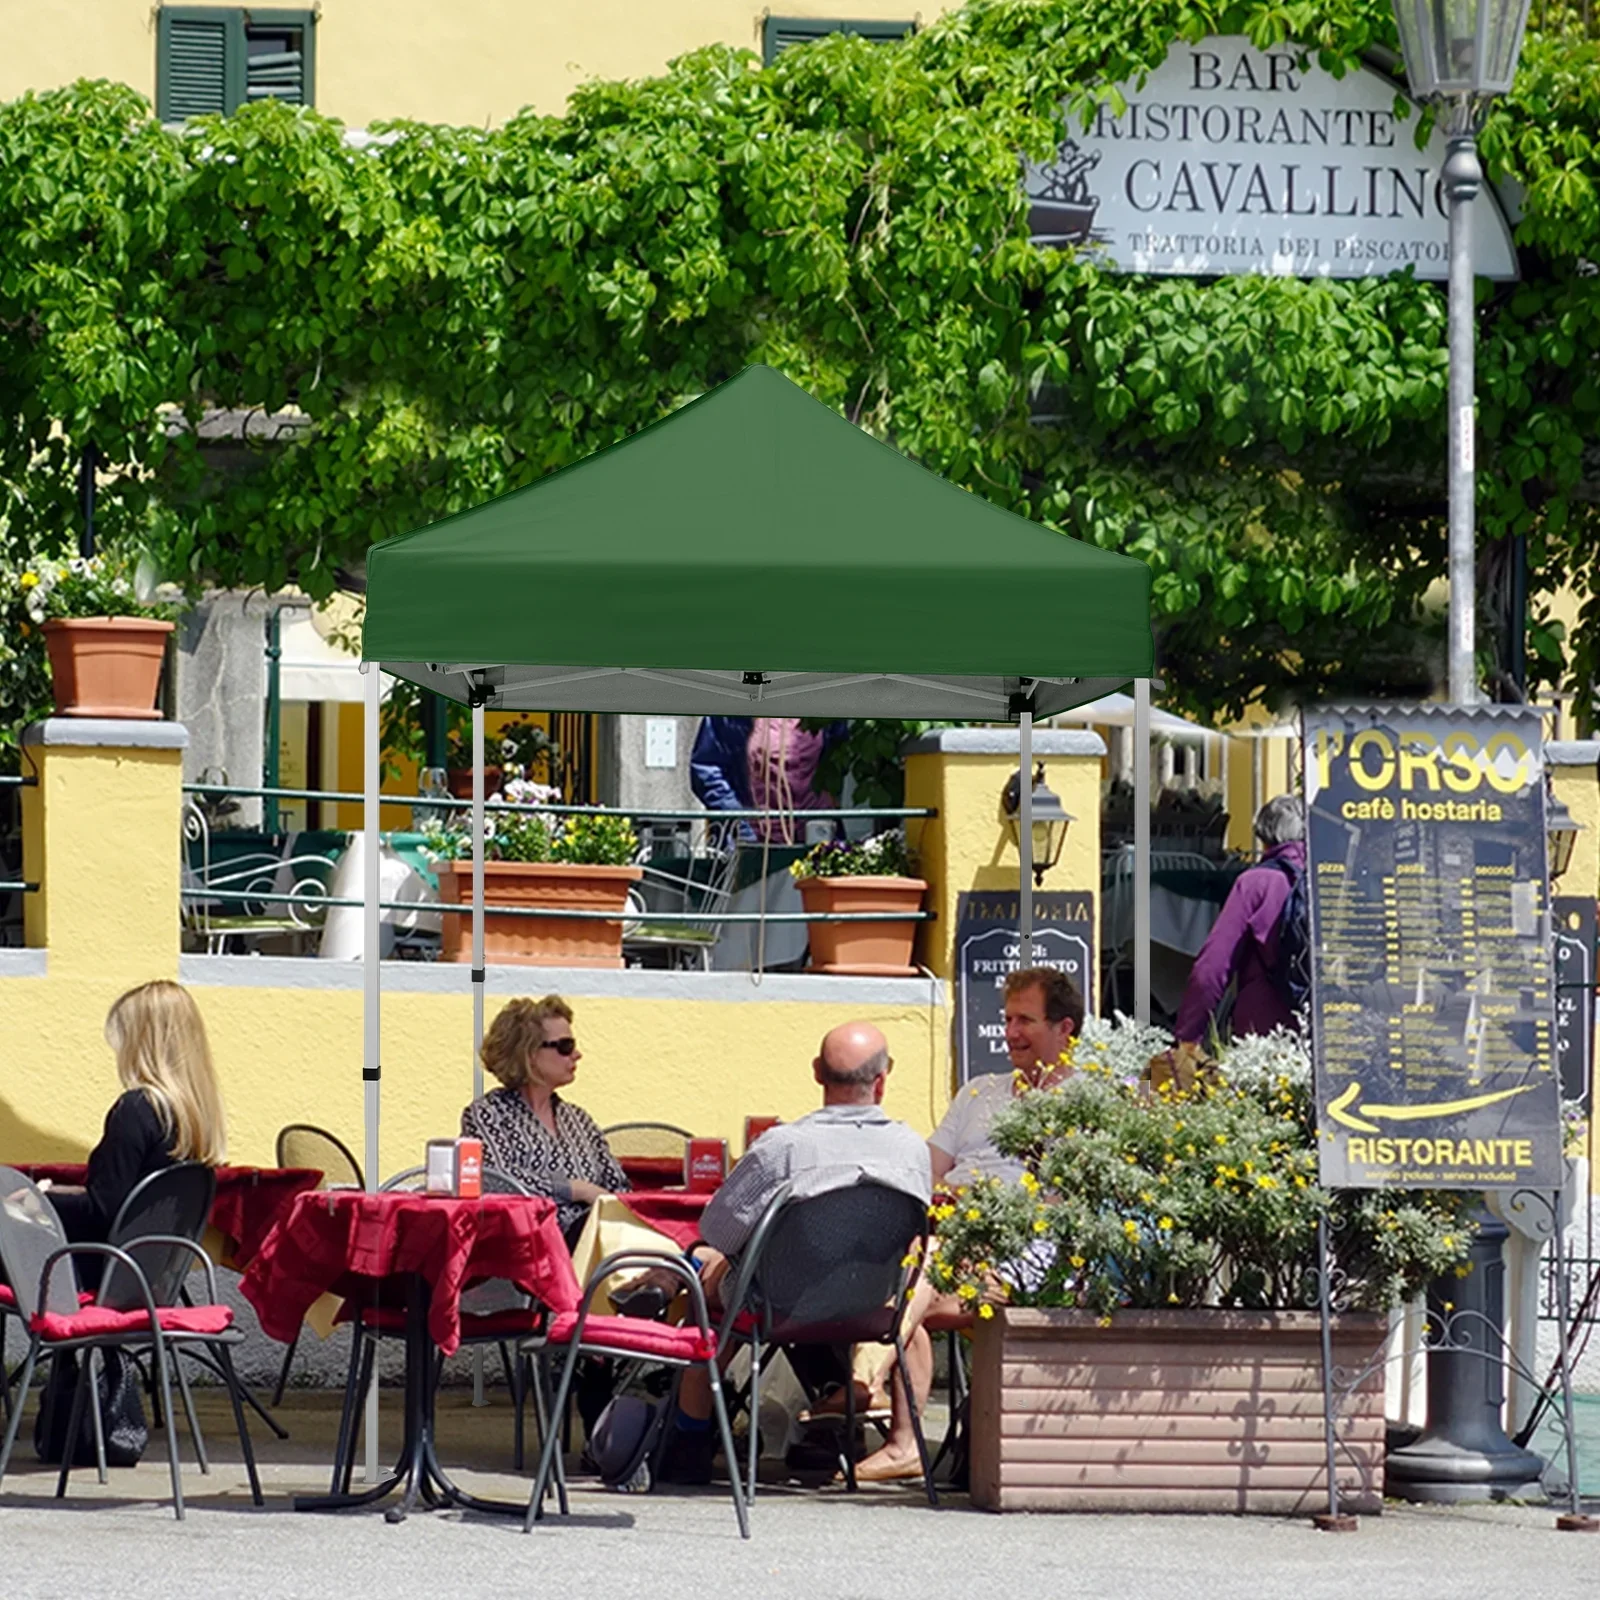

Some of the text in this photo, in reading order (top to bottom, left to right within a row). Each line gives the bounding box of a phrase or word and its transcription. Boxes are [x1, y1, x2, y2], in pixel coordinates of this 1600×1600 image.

[1189, 51, 1300, 92] BAR
[1092, 101, 1395, 147] RISTORANTE
[1128, 232, 1264, 256] TRATTORIA
[1278, 237, 1320, 258] DEI
[1342, 797, 1502, 821] cafè hostaria
[1317, 863, 1345, 875] pizza
[1396, 863, 1426, 875] pasta
[1322, 1001, 1361, 1014] piadine
[1347, 1138, 1533, 1166] RISTORANTE
[1442, 1172, 1475, 1182] service
[1478, 1171, 1517, 1182] included
